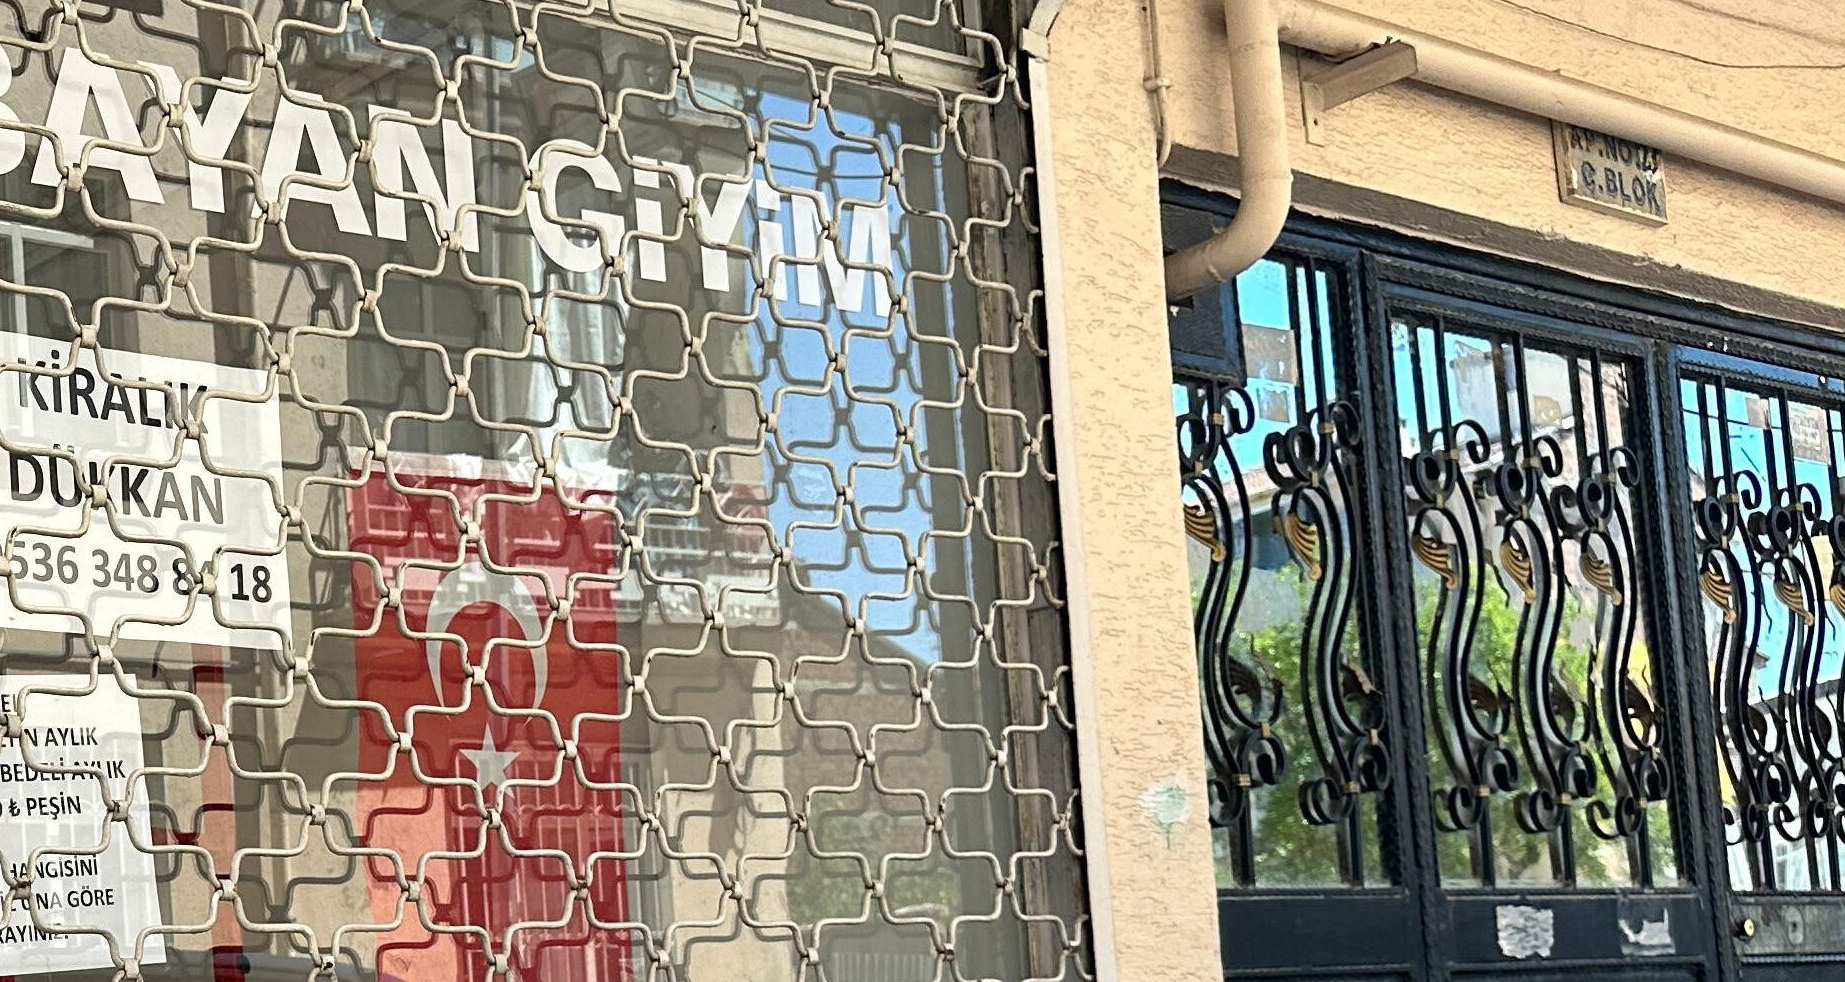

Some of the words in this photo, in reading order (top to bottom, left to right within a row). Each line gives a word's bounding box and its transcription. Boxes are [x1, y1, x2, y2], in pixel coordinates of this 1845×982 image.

[18, 350, 209, 434] KİRALIK
[92, 549, 160, 593] 348
[230, 563, 273, 603] 18
[44, 727, 99, 747] AYLIK
[26, 792, 82, 820] PEŞİN
[67, 885, 115, 908] GÖRE
